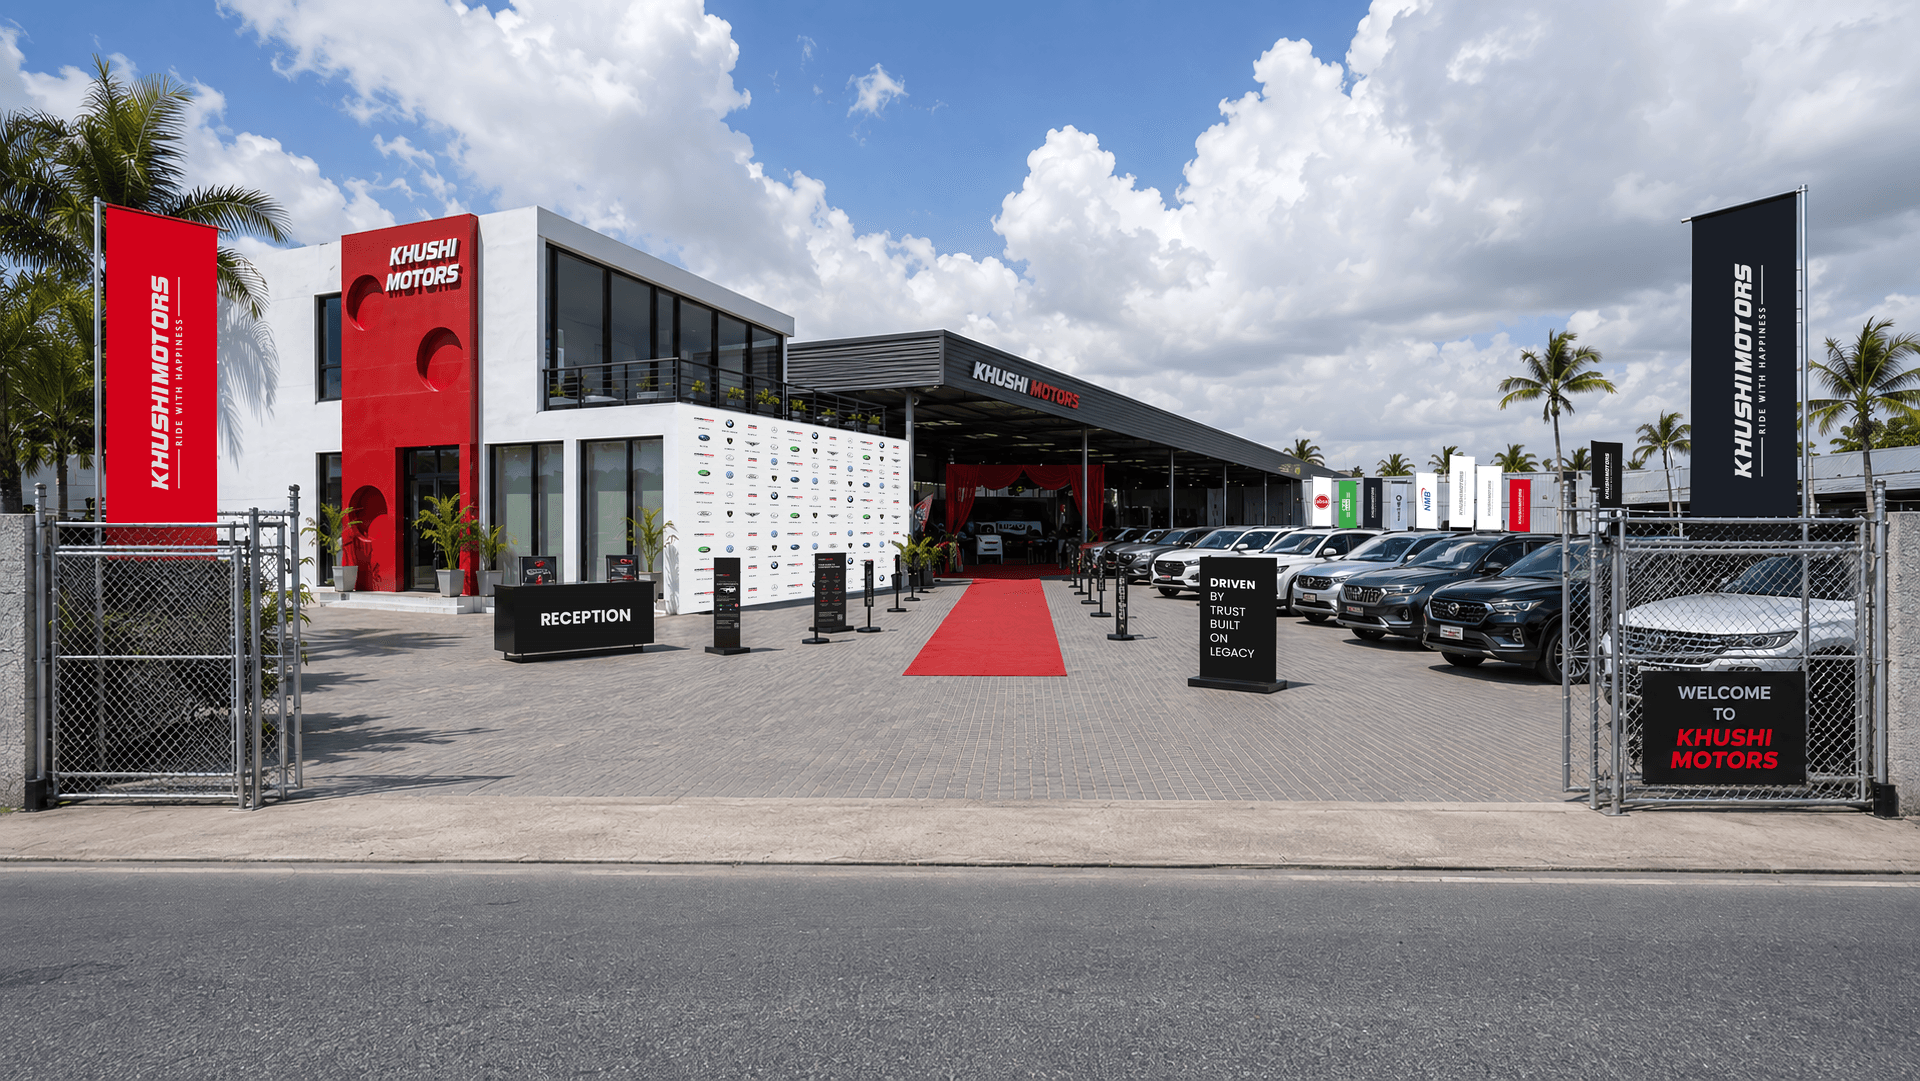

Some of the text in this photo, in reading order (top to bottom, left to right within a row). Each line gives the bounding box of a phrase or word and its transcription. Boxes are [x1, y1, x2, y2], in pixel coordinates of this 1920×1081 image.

[389, 238, 459, 267] KHUSHI
[385, 263, 460, 292] MOTORS
[1734, 263, 1753, 479] KHUSHIMOTORS
[1758, 307, 1766, 435] RIDE WITH HAPPINESS
[151, 275, 169, 491] KHUSHIMOTORS
[175, 319, 183, 447] RIDE WITH HAPPINESS
[972, 360, 1080, 409] KHUSHI MOTORS
[1423, 491, 1431, 512] NMB
[1210, 577, 1256, 590] DRIVEN
[1210, 591, 1225, 602] BY
[540, 608, 631, 627] RECEPTION
[1210, 605, 1246, 617] TRUST
[1210, 619, 1240, 630] BUILT
[1210, 632, 1228, 644] ON
[1210, 646, 1255, 659] LEGACY
[1678, 685, 1771, 700] WELCOME
[1713, 707, 1736, 721] TO
[1676, 728, 1773, 747] KHUSHI
[1670, 750, 1779, 769] MOTORS
